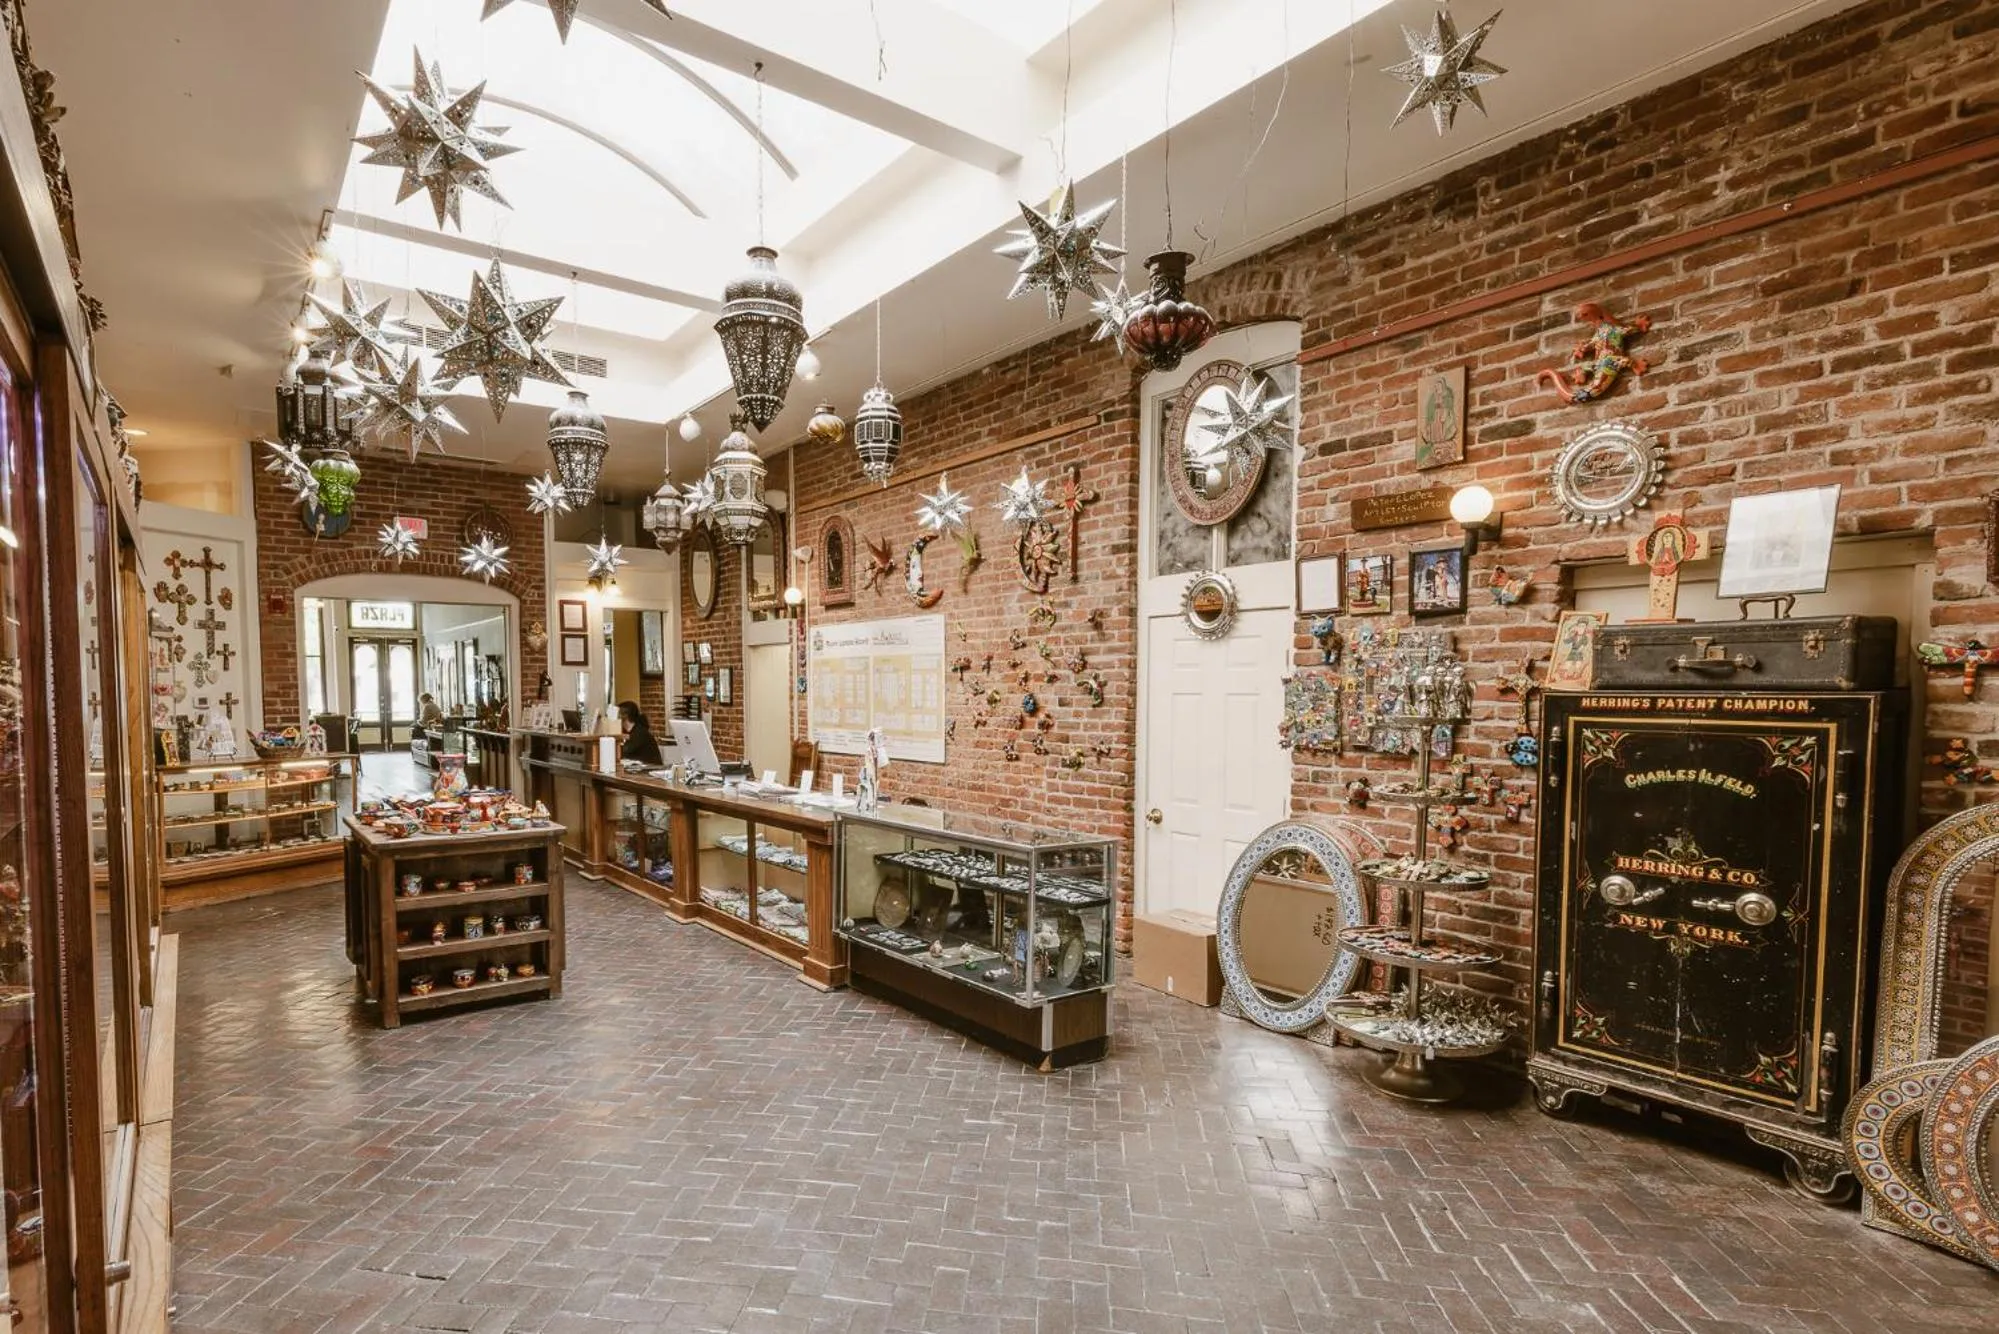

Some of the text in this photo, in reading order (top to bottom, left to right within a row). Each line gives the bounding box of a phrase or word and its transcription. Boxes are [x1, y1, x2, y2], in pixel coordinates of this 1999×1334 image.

[1581, 697, 1816, 711] HERRING'S PATENT CHAMPION.
[1624, 769, 1697, 788] CHARLES
[1616, 856, 1760, 886] HERRING & CO.
[1619, 913, 1750, 945] NEW YORK.
